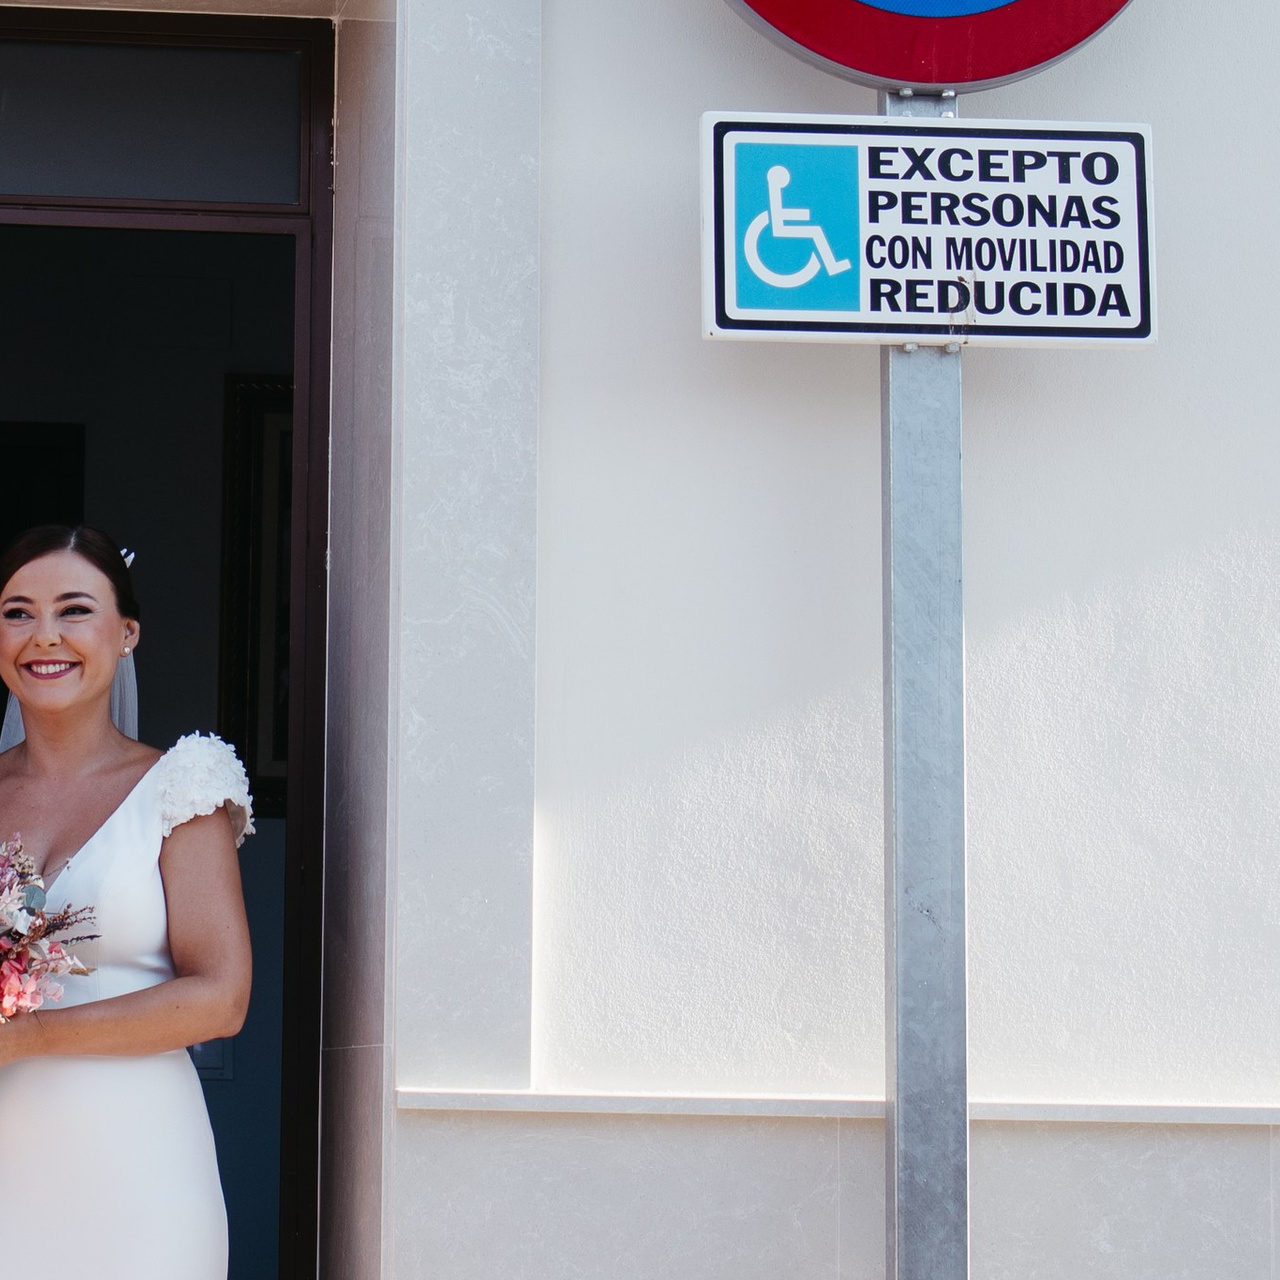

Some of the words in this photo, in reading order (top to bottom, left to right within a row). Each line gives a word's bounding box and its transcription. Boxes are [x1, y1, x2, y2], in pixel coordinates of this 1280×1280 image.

[867, 146, 1120, 186] EXCEPTO
[867, 190, 1121, 230] PERSONAS
[865, 234, 933, 270] CON
[945, 237, 1125, 275] MOVILIDAD
[868, 277, 1132, 317] REDUCIDA
